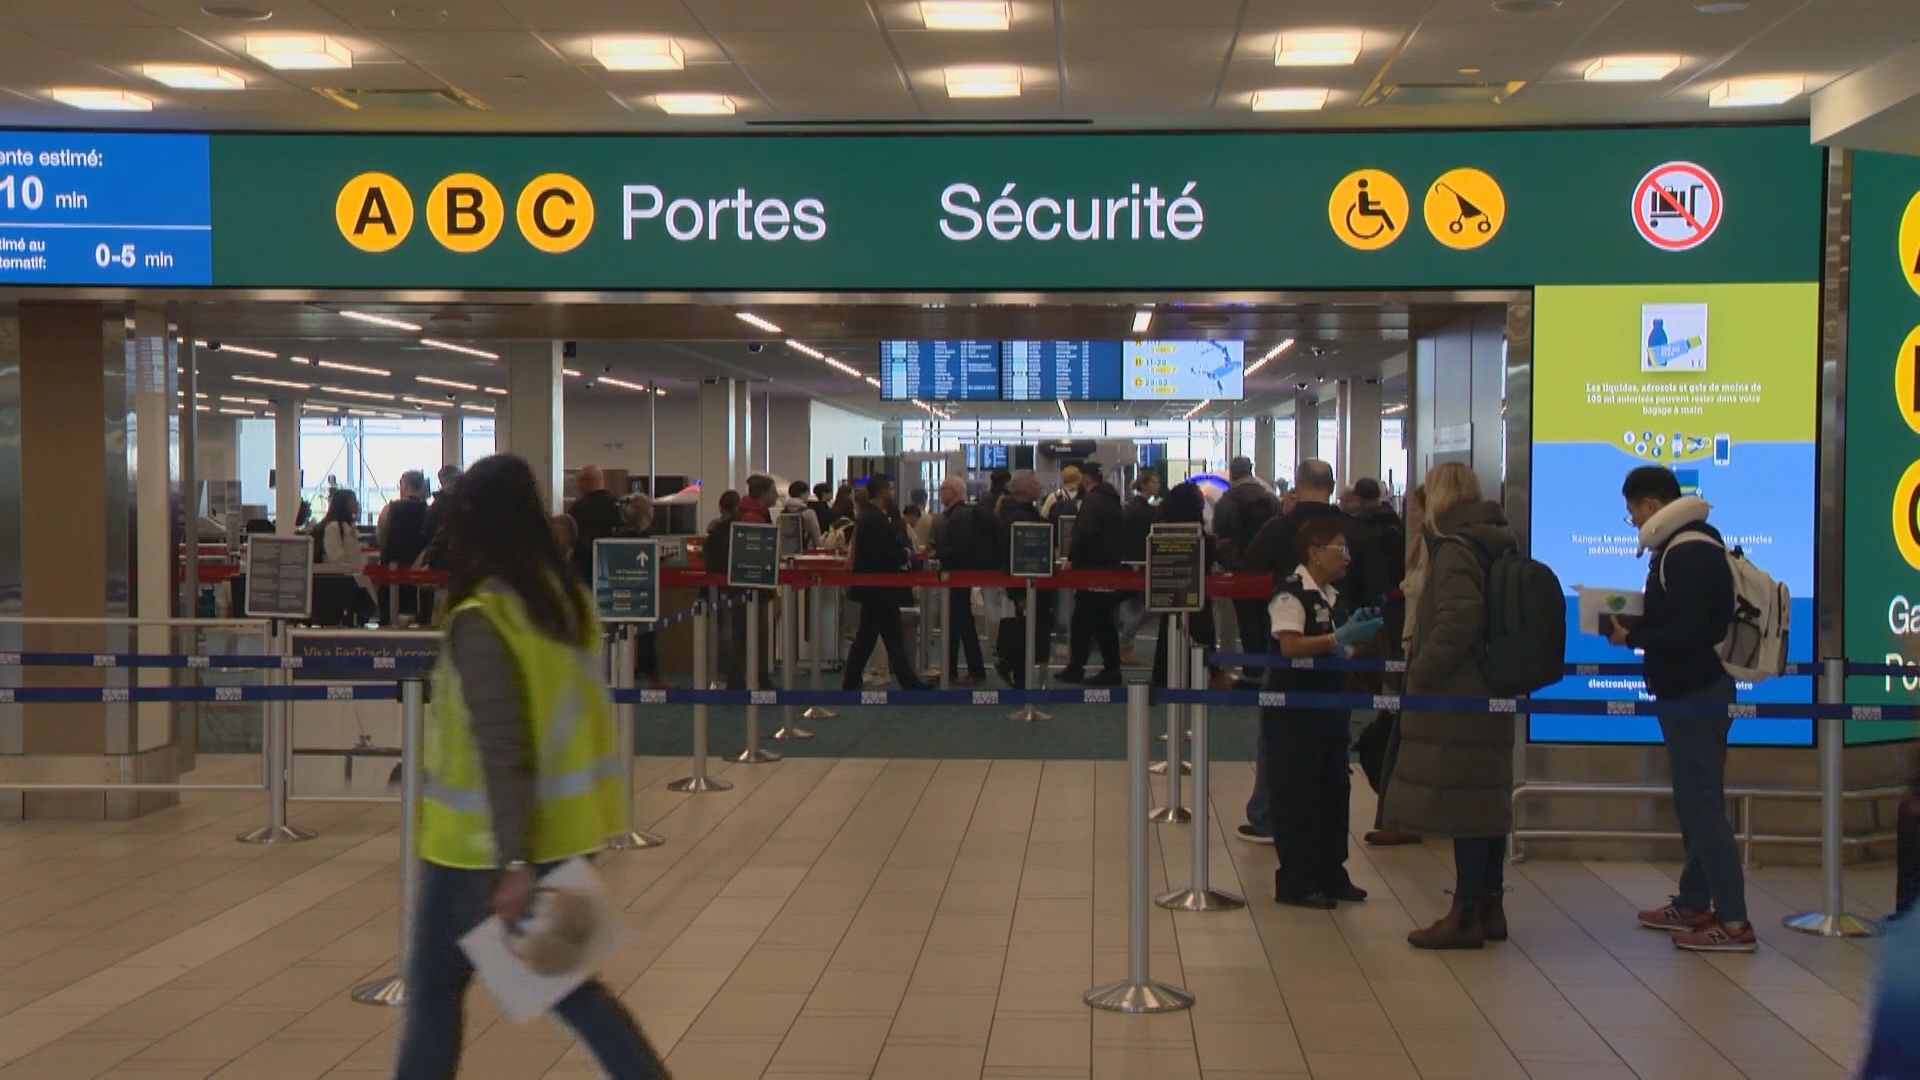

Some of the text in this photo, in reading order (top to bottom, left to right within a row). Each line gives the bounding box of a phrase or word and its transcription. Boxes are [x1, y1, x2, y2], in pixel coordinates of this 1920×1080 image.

[39, 149, 103, 167] estimé:
[55, 191, 88, 209] min
[353, 181, 1204, 241] A B C Portes Sécurité
[29, 239, 46, 252] au
[95, 243, 174, 268] 0-5 min
[1586, 383, 1762, 395] Les liquides, aérosols et gels de moins de
[1586, 395, 1601, 404] 100
[1655, 396, 1690, 406] peuvent
[1716, 395, 1737, 404] dans
[1738, 395, 1761, 404] votre
[1642, 406, 1672, 417] bagage
[1681, 406, 1703, 415] main
[1739, 534, 1773, 545] articles
